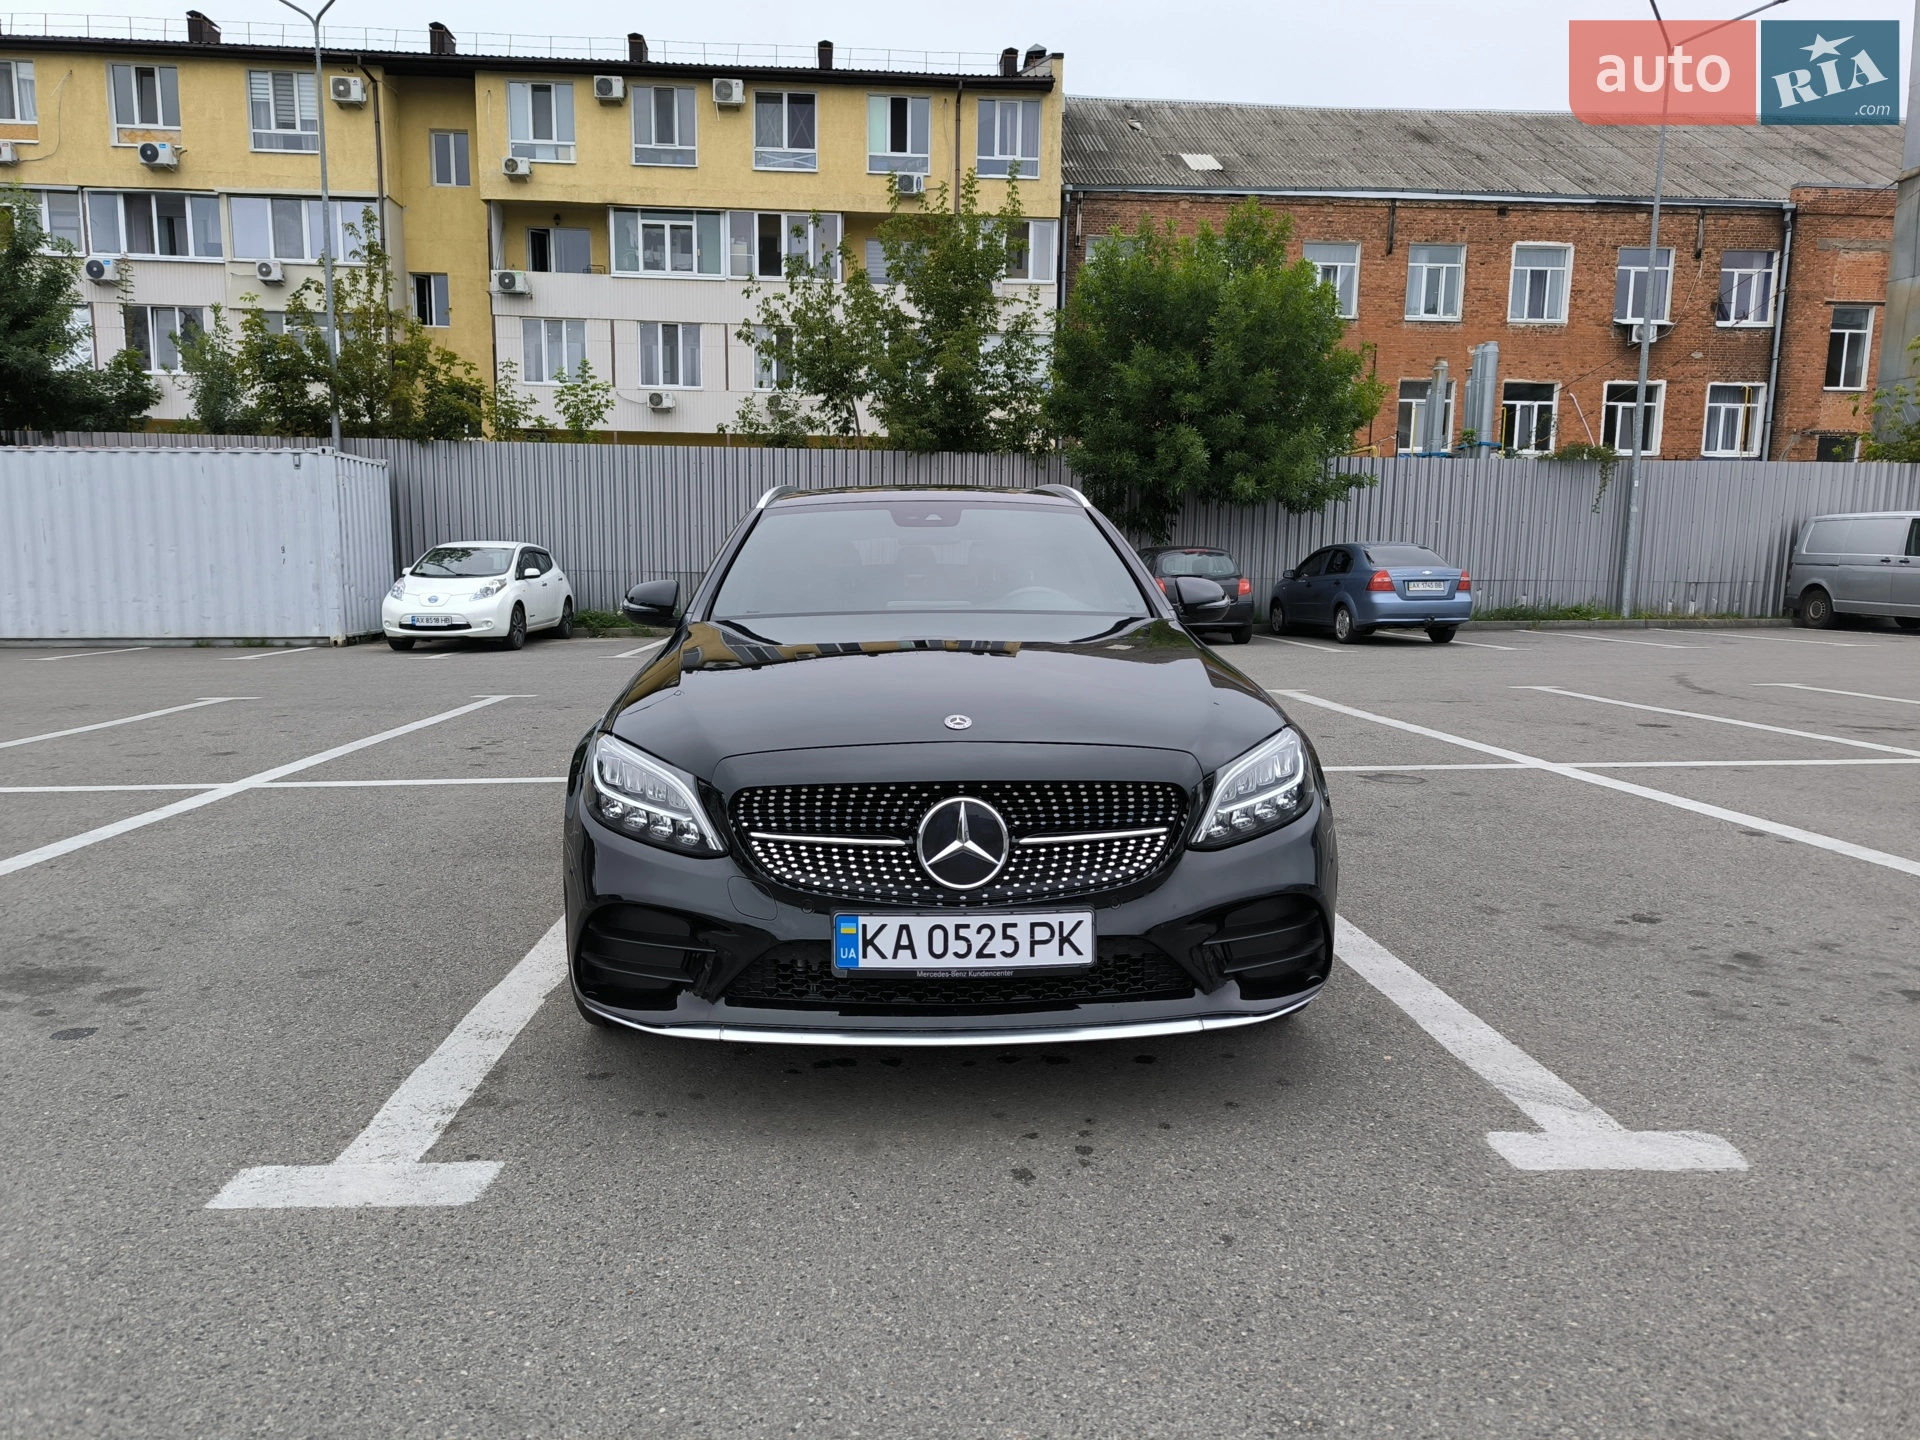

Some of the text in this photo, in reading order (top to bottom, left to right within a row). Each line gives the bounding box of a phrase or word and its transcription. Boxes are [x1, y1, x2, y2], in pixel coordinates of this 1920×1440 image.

[861, 919, 1084, 960] KA 0525 PK
[840, 947, 857, 960] UA
[916, 969, 1014, 978] Mercedes-Benz Kundencenter
